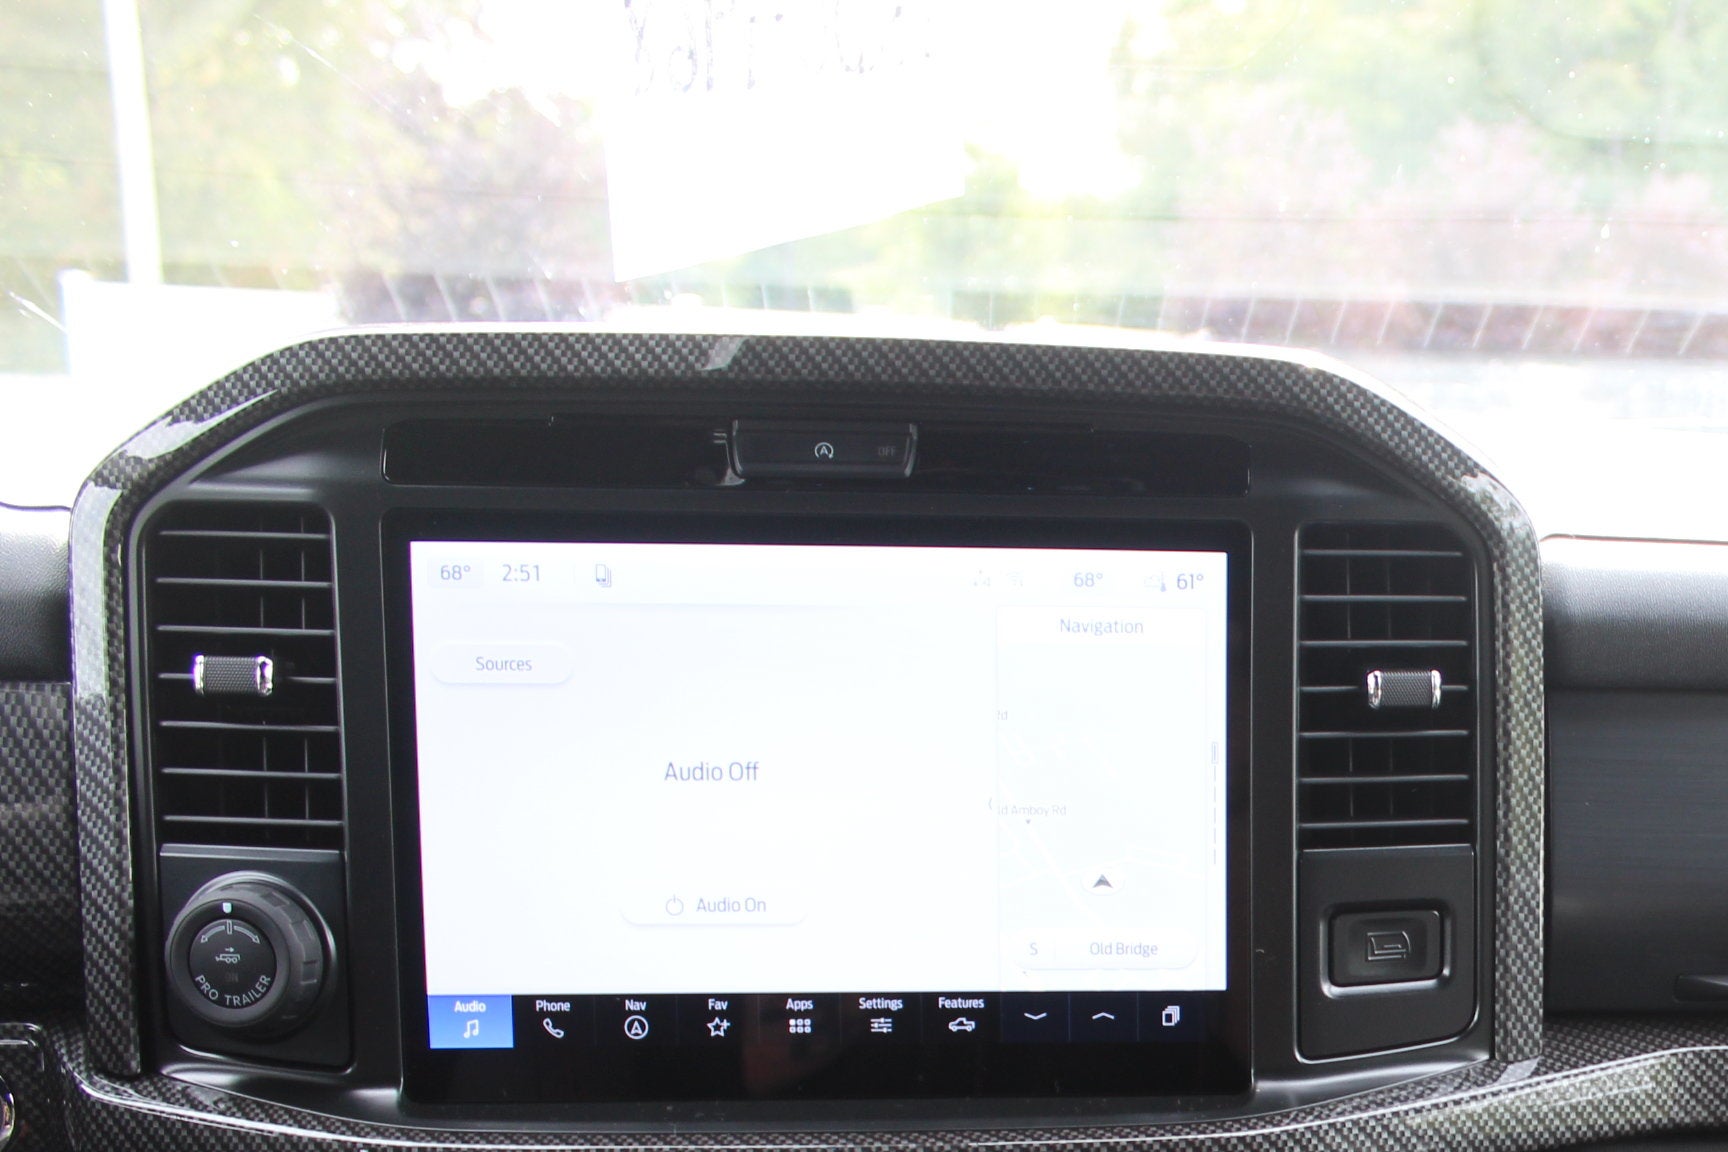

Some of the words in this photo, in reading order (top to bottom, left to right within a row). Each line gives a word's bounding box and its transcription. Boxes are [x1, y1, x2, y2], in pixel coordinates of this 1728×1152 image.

[502, 564, 541, 583] 2:51
[1059, 618, 1144, 636] Navigation
[475, 656, 533, 672] Sources
[664, 761, 724, 782] Audio
[728, 761, 760, 782] Off
[696, 897, 741, 913] Audio
[744, 897, 766, 913] On
[1089, 942, 1113, 956] Old
[1115, 942, 1158, 957] Bridge
[195, 974, 219, 1000] PRO
[224, 974, 271, 1007] TRAILER
[454, 1000, 486, 1013] Audio
[535, 999, 571, 1012] Phone
[625, 999, 647, 1011] Nav
[708, 998, 728, 1010] Fav
[785, 998, 814, 1012] Apps
[858, 997, 903, 1011] Settings
[938, 997, 985, 1009] Features
